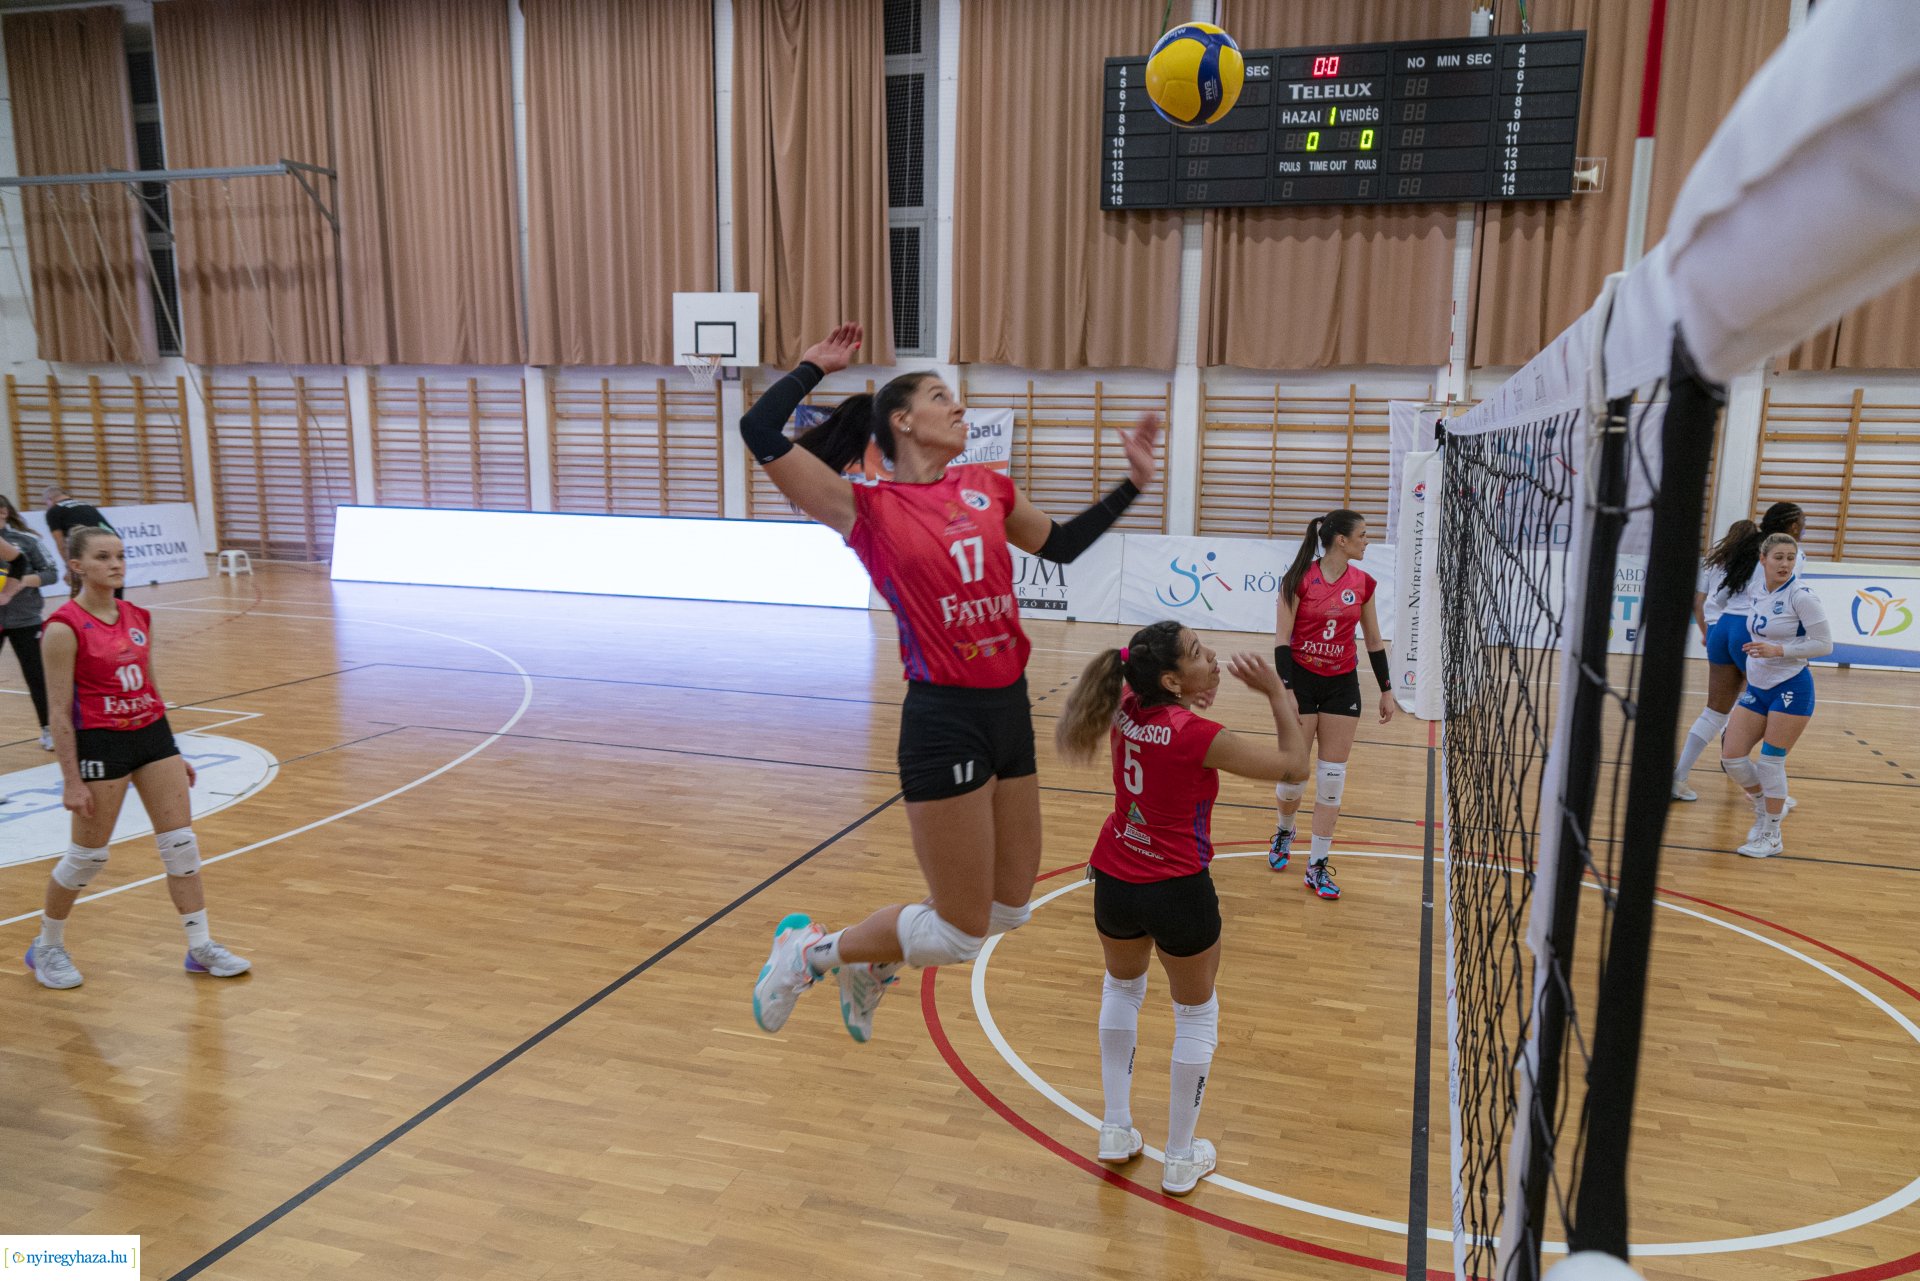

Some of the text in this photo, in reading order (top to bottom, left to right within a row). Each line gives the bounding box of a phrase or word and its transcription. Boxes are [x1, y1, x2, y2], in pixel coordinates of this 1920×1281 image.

[1519, 44, 1527, 55] 4
[1407, 53, 1492, 69] NO MIN SEC
[1518, 57, 1526, 68] 5
[1120, 66, 1127, 77] 4
[1246, 66, 1270, 77] SEC
[1517, 70, 1525, 81] 6
[1120, 78, 1127, 88] 5
[1516, 83, 1524, 94] 7
[1119, 90, 1126, 100] 6
[1288, 83, 1372, 100] TELELUX
[1119, 102, 1126, 111] 7
[1515, 96, 1522, 107] 8
[1118, 114, 1126, 123] 8
[1282, 111, 1321, 124] HAZAI
[1340, 105, 1379, 122] VENDÉG
[1514, 109, 1521, 119] 9
[1118, 126, 1125, 135] 9
[1507, 122, 1520, 132] 10
[1113, 138, 1125, 147] 10
[1306, 131, 1320, 151] 0
[1360, 129, 1374, 150] 0
[1505, 135, 1517, 145] 11
[1112, 149, 1123, 159] 11
[1505, 148, 1518, 158] 12
[1112, 161, 1124, 171] 12
[1279, 161, 1301, 172] FOULS
[1309, 160, 1347, 171] TIME OUT
[1354, 159, 1377, 170] FOULS
[1504, 160, 1517, 170] 13
[1111, 172, 1124, 182] 13
[1502, 173, 1516, 183] 14
[1111, 184, 1123, 194] 14
[1501, 185, 1515, 195] 15
[1110, 195, 1123, 205] 15
[123, 541, 188, 559] ENTRUM
[949, 535, 984, 584] 17
[1044, 601, 1066, 609] KFT
[1323, 619, 1337, 640] 3
[115, 663, 144, 693] 10
[80, 759, 105, 779] 10
[1124, 739, 1144, 795] 5
